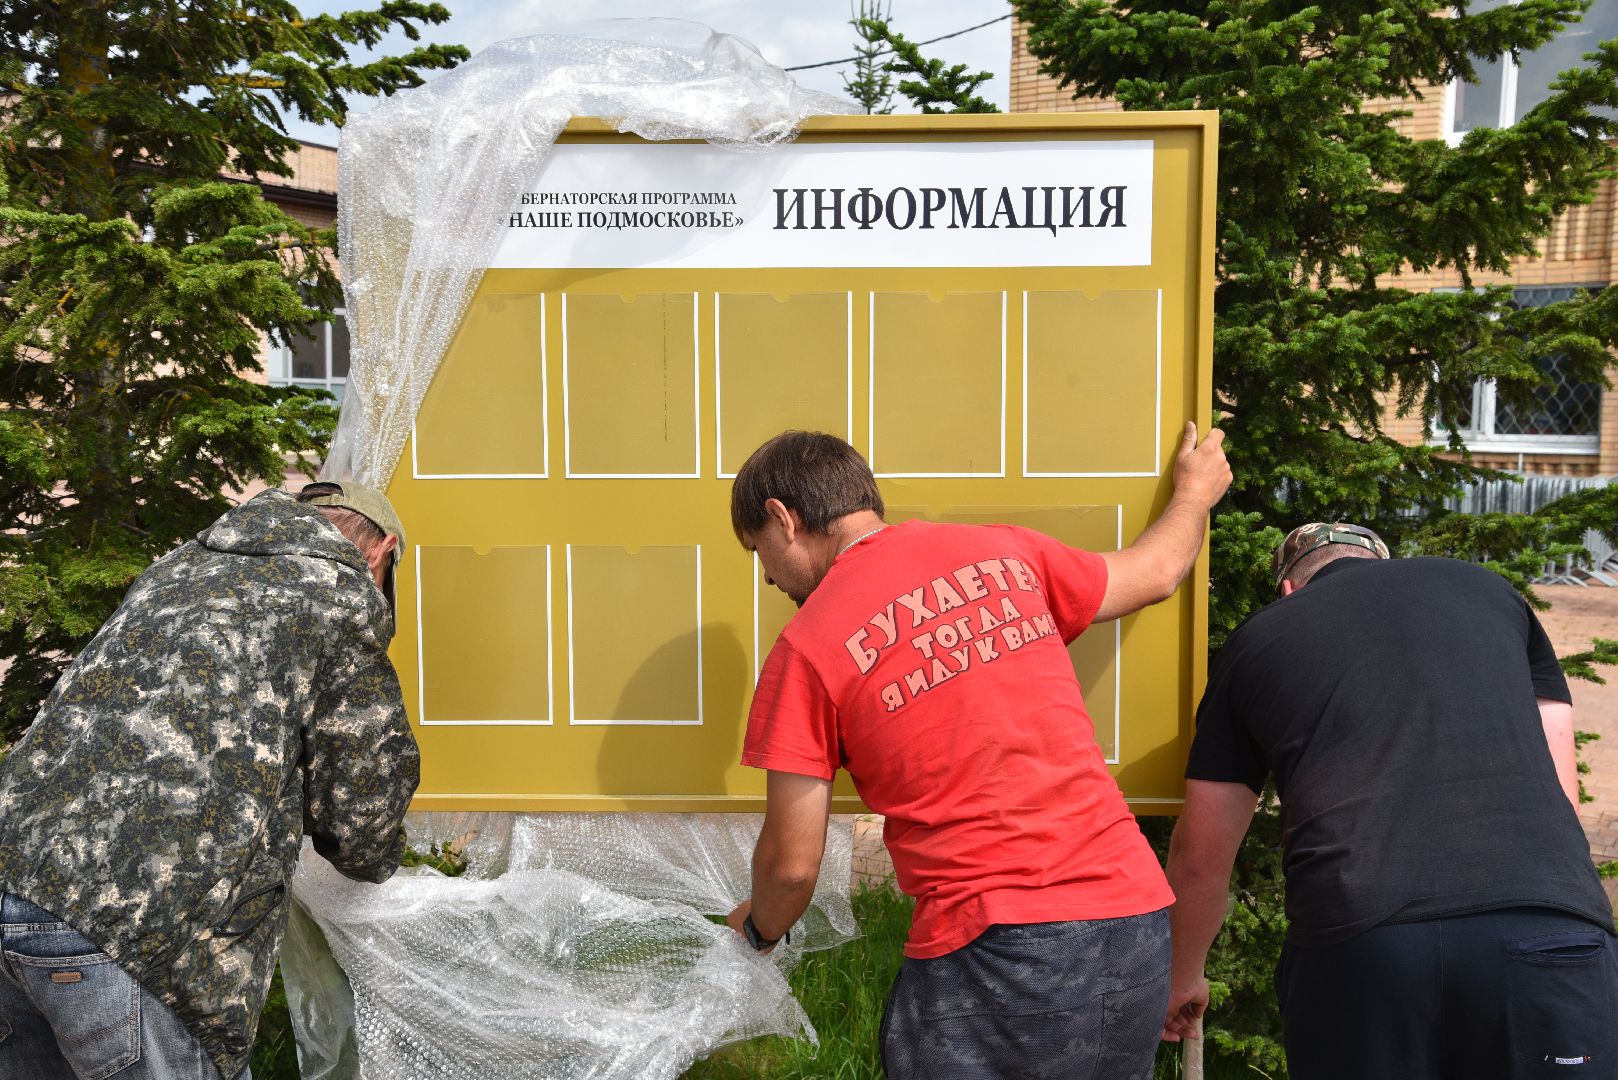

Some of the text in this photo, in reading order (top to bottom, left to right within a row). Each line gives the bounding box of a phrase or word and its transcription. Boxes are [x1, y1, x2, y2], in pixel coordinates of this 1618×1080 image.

[521, 192, 738, 205] БЕРНАТОРСКАЯ ПРОГРАММА
[577, 211, 744, 231] ПОДМОСКОВЬЕ»
[772, 185, 1128, 238] ИНФОРМАЦИЯ
[911, 596, 1023, 660] ТОГДА
[880, 681, 906, 712] Я
[904, 645, 970, 698] ИДУ
[973, 635, 1001, 664] К
